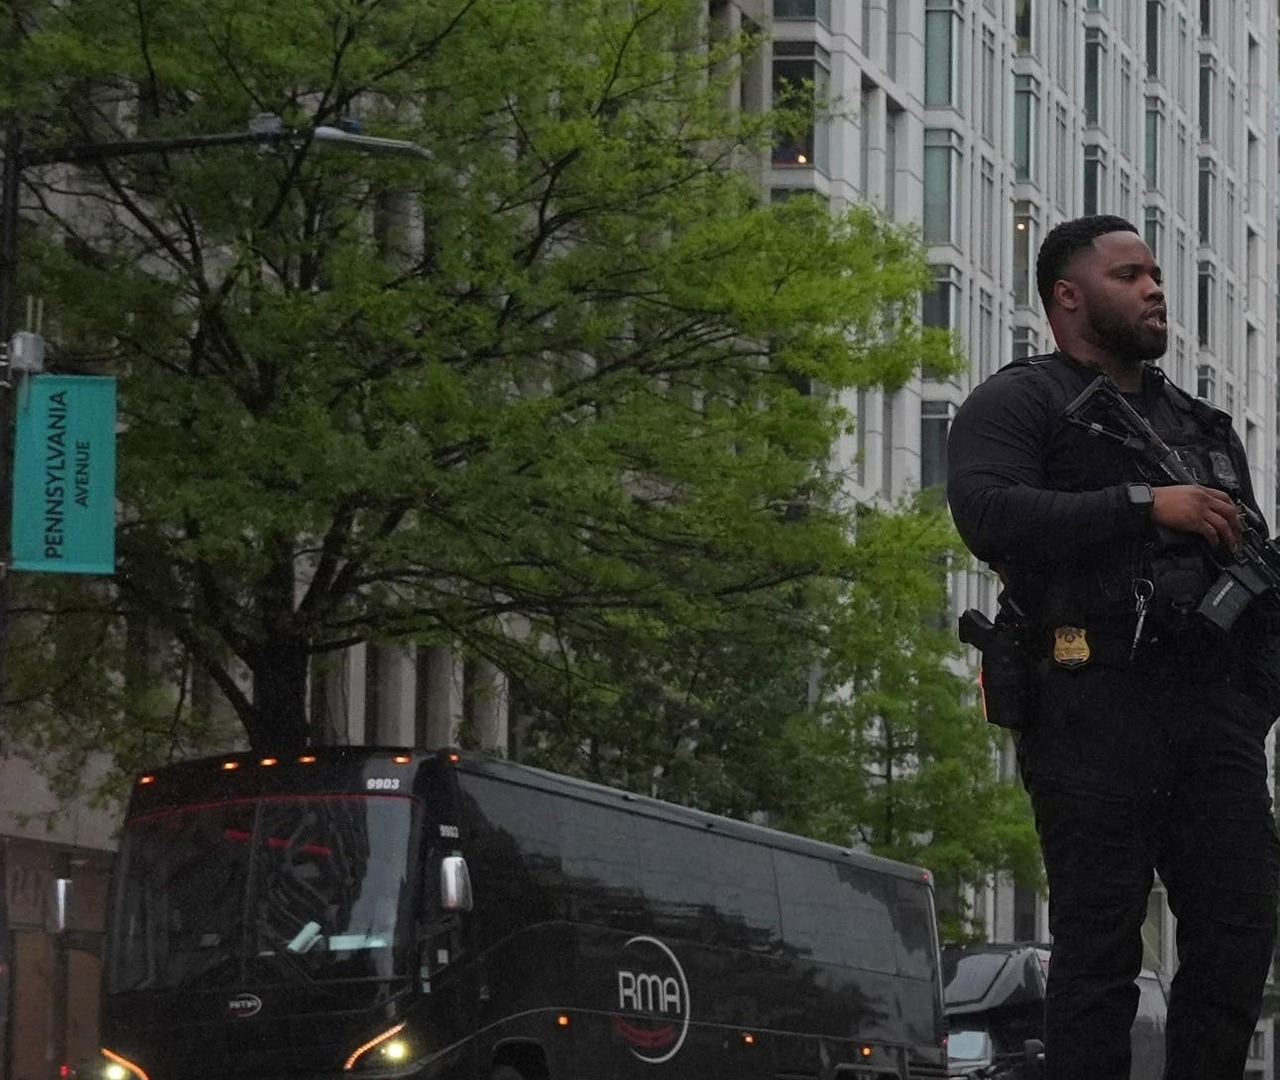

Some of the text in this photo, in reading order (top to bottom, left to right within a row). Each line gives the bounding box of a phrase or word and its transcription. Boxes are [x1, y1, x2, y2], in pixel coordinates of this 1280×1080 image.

[45, 390, 68, 559] PENNSYLVANIA
[75, 440, 90, 508] AVENUE
[366, 778, 400, 790] 9903
[619, 970, 681, 1014] RMA
